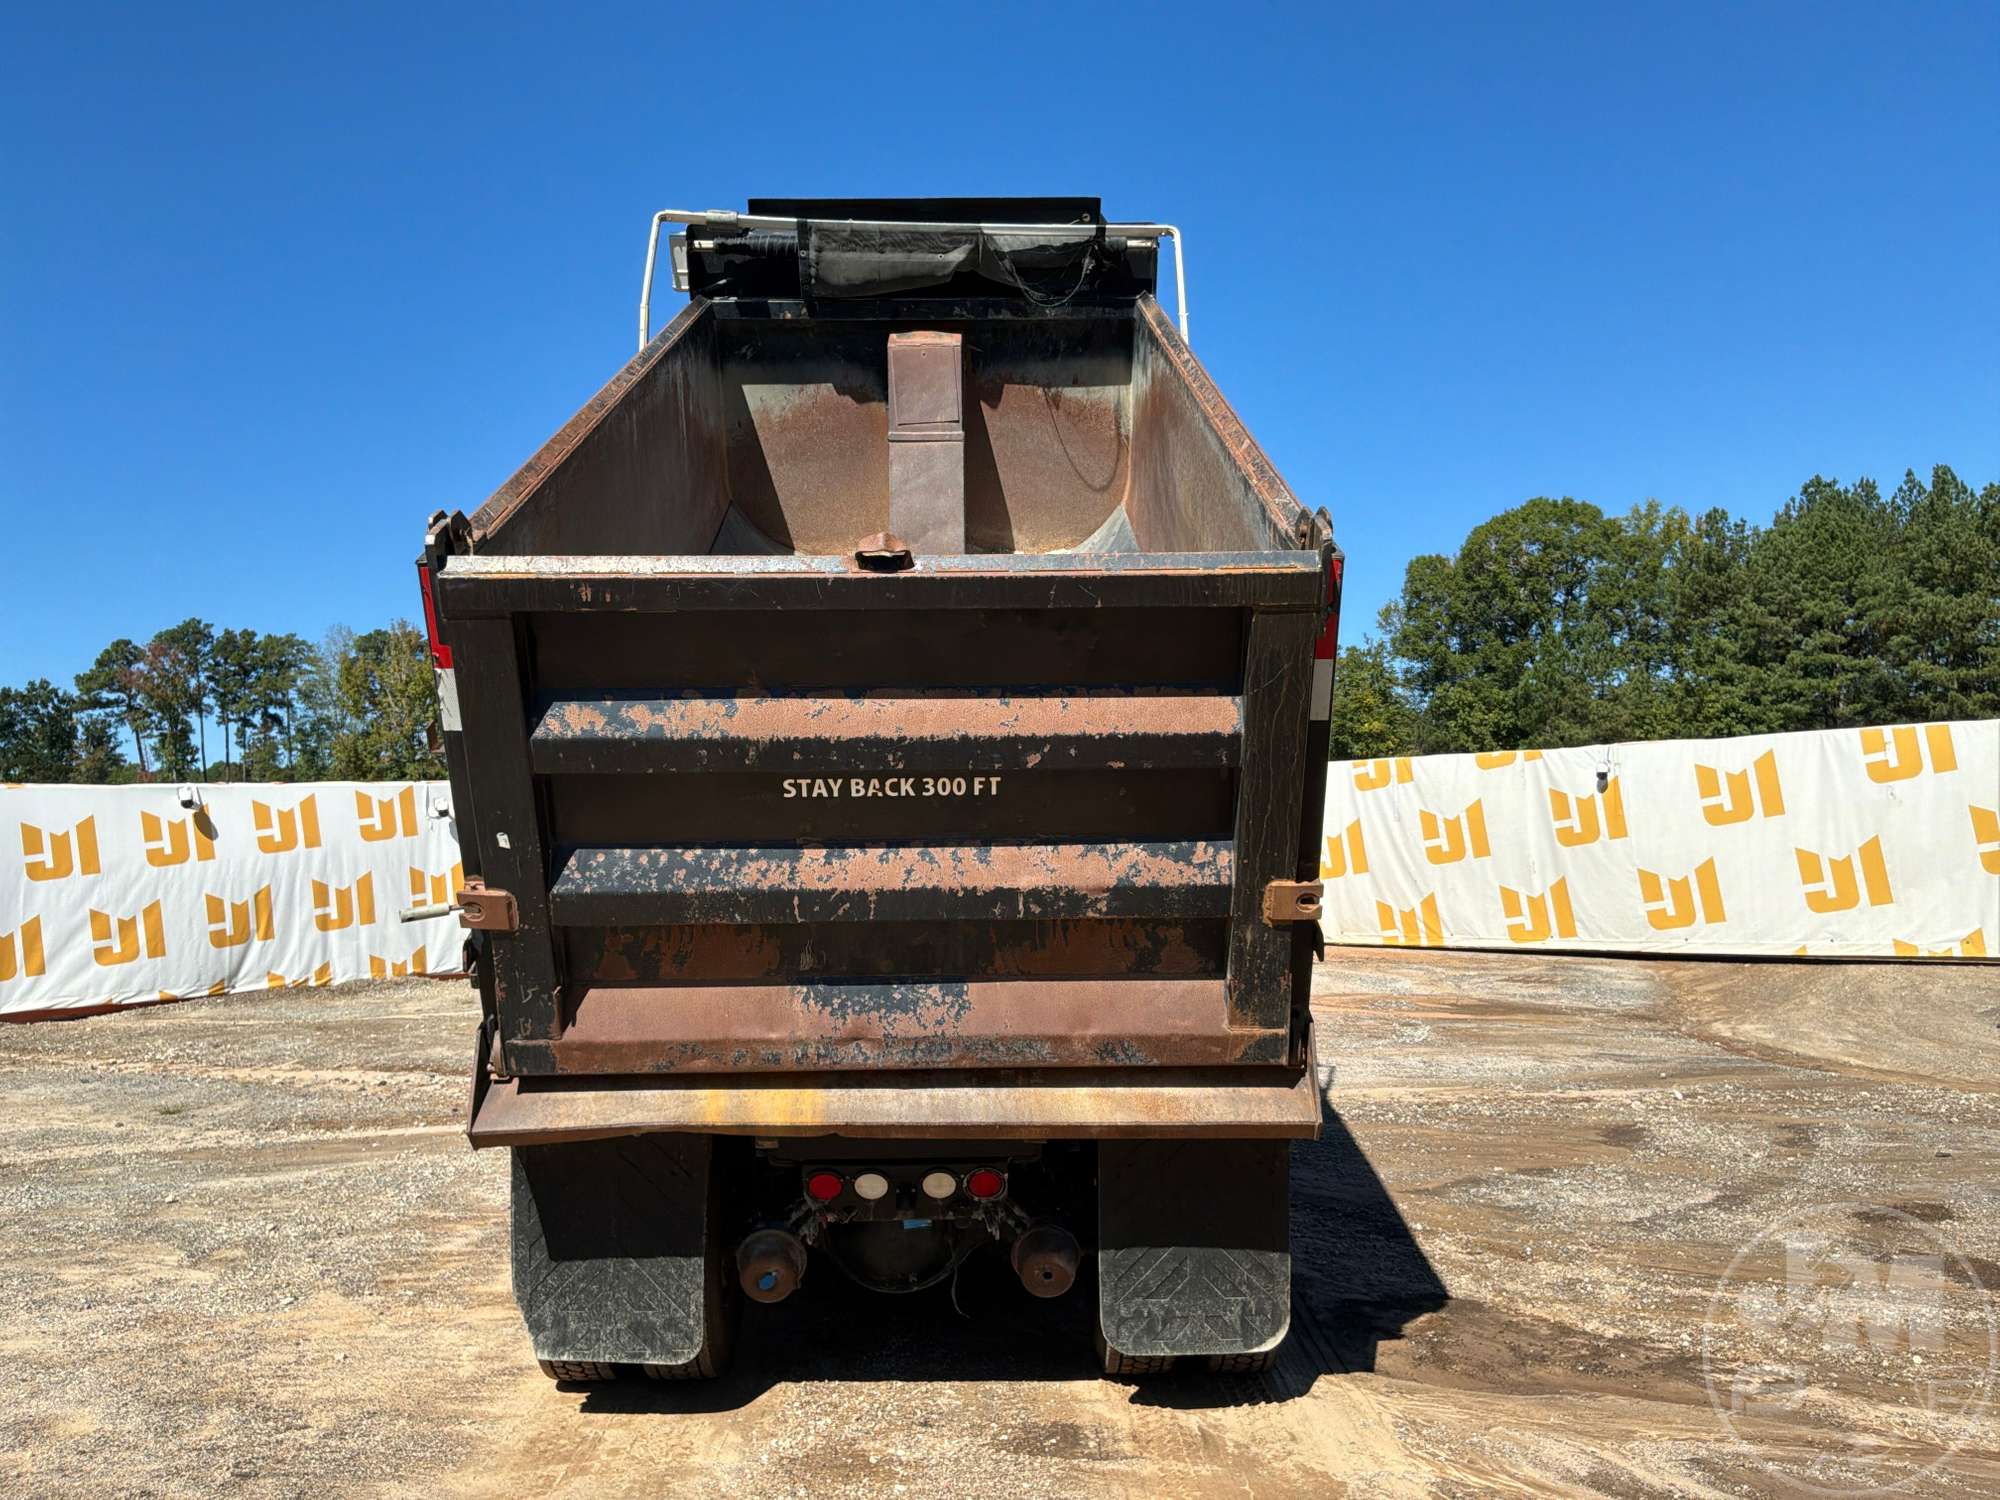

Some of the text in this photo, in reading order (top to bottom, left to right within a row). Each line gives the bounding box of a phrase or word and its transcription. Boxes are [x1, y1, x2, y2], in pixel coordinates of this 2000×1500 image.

[782, 776, 1001, 798] STAY BACK 300 FT
